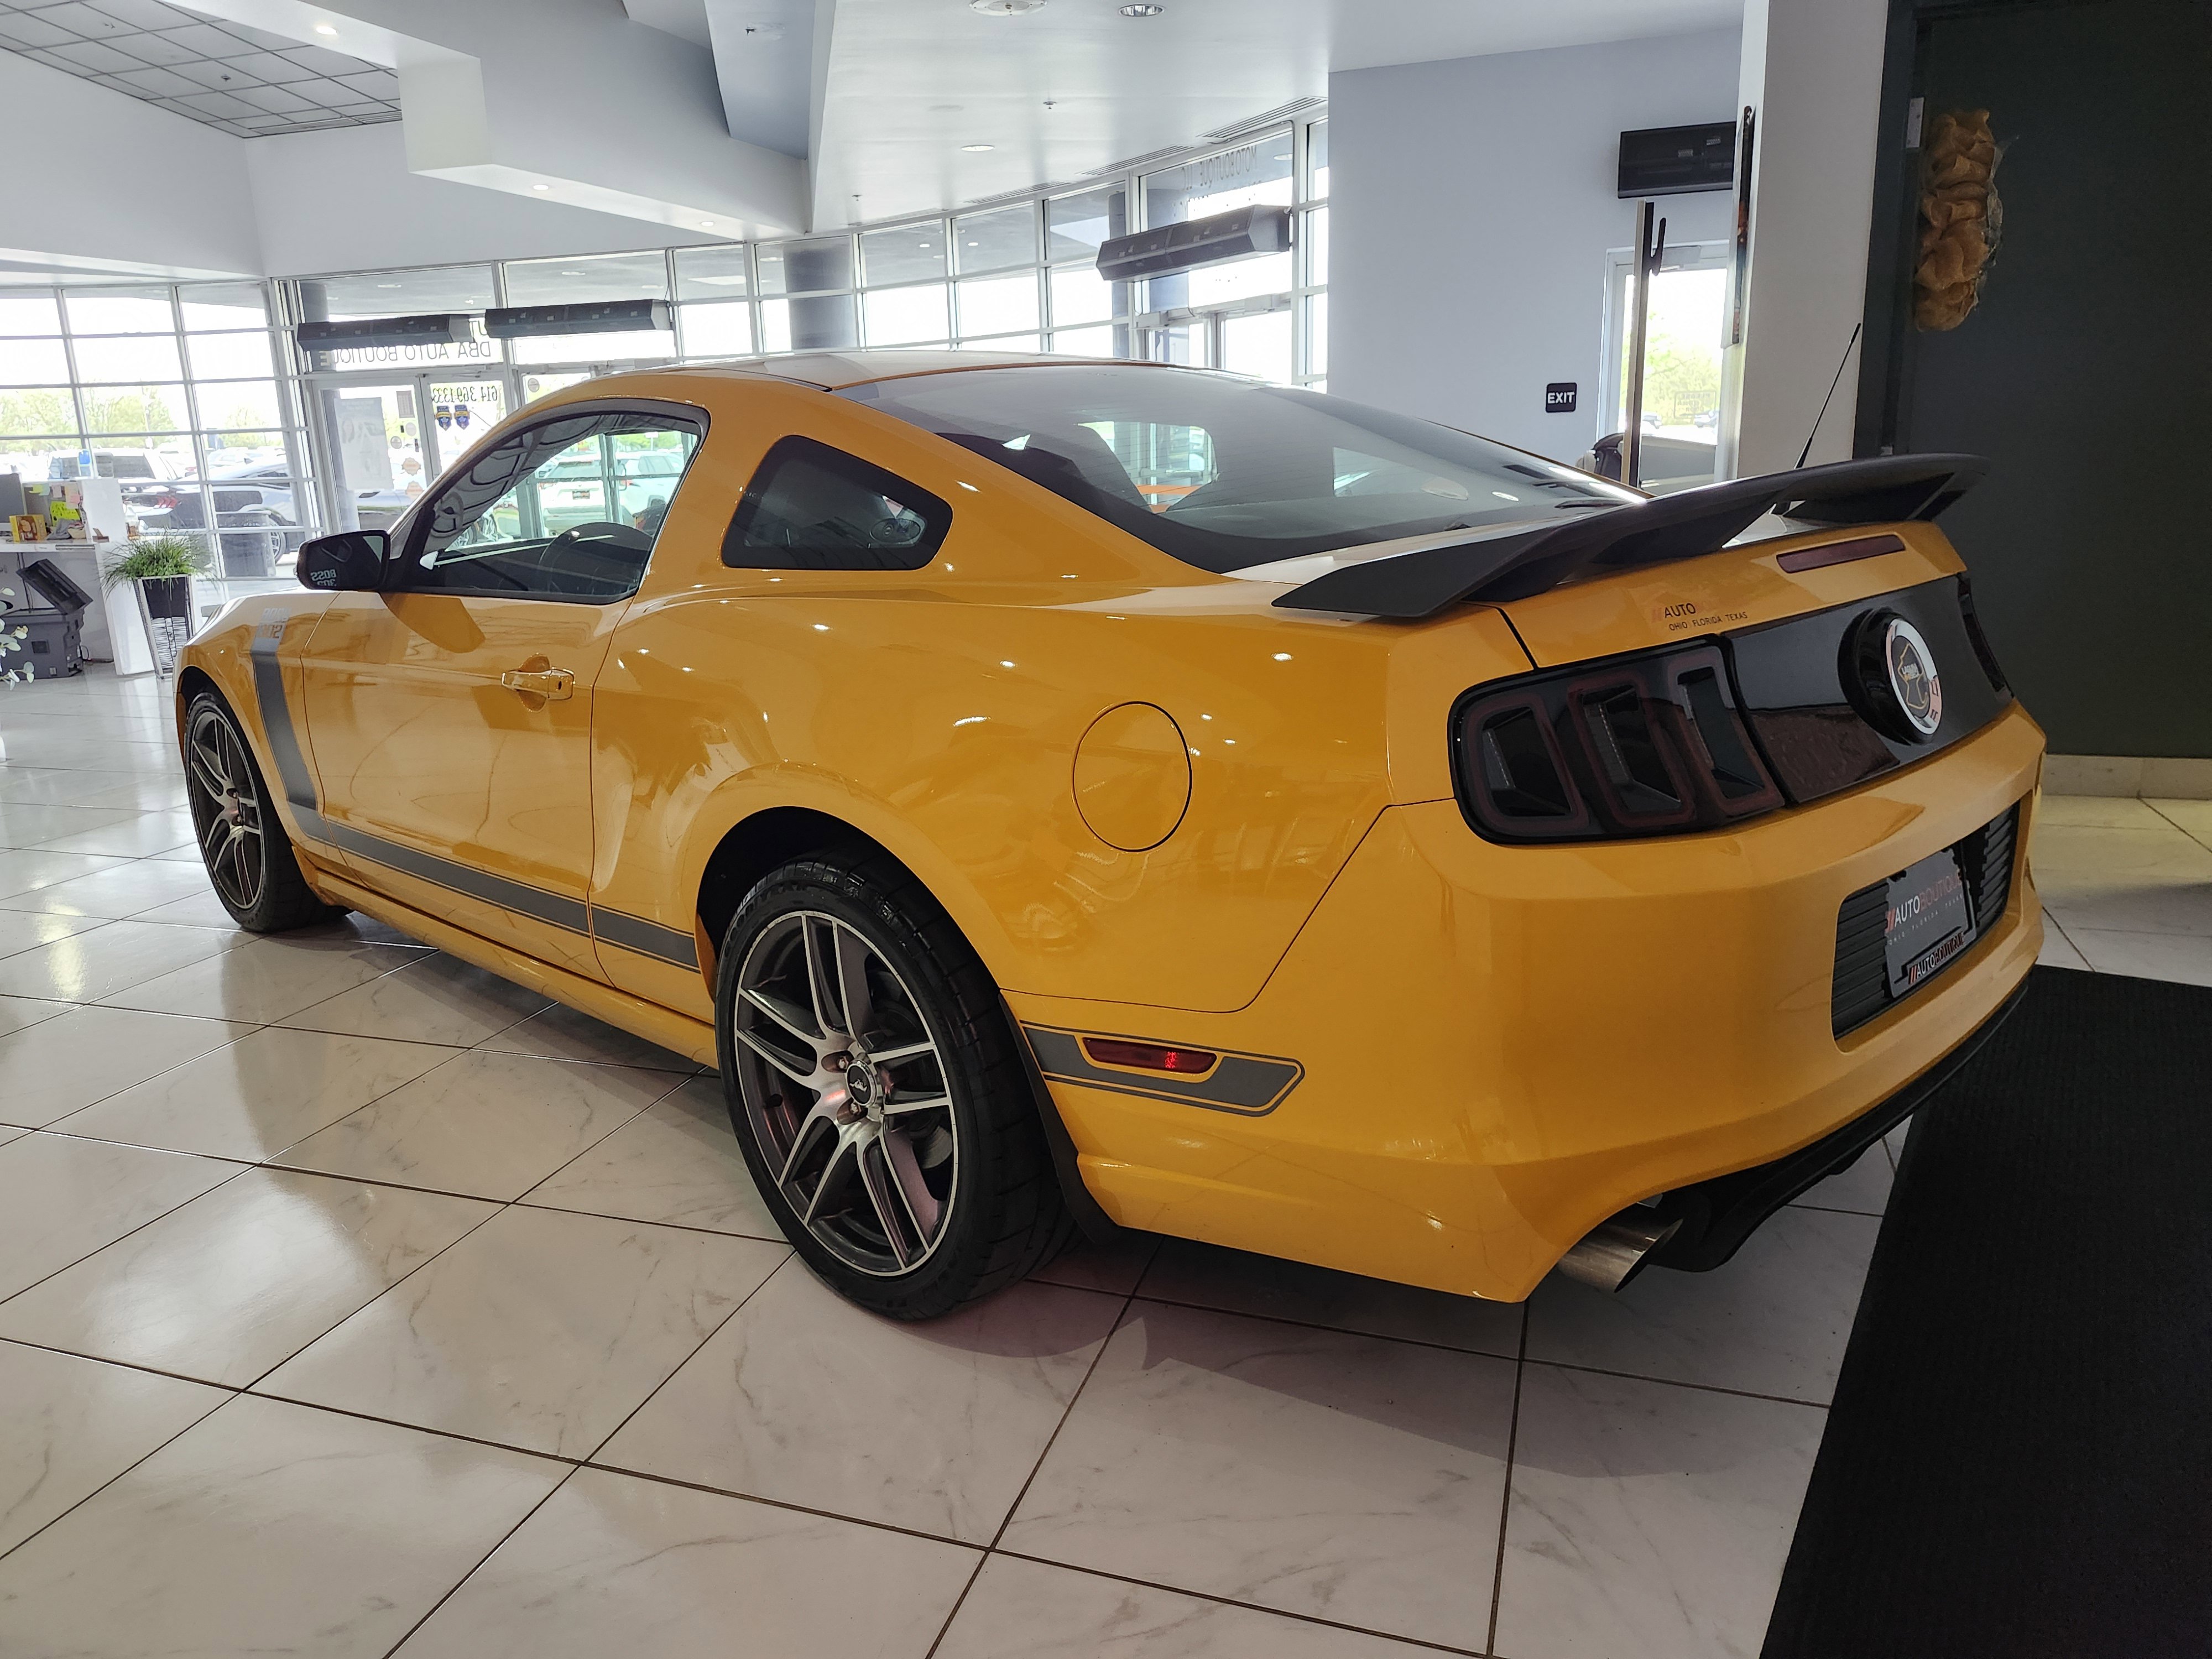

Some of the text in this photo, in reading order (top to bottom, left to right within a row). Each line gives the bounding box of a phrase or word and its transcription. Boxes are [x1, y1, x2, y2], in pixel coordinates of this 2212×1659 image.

[1547, 391, 1575, 404] EXIT
[1669, 611, 1748, 631] OHIO FLORIDA TEXAS
